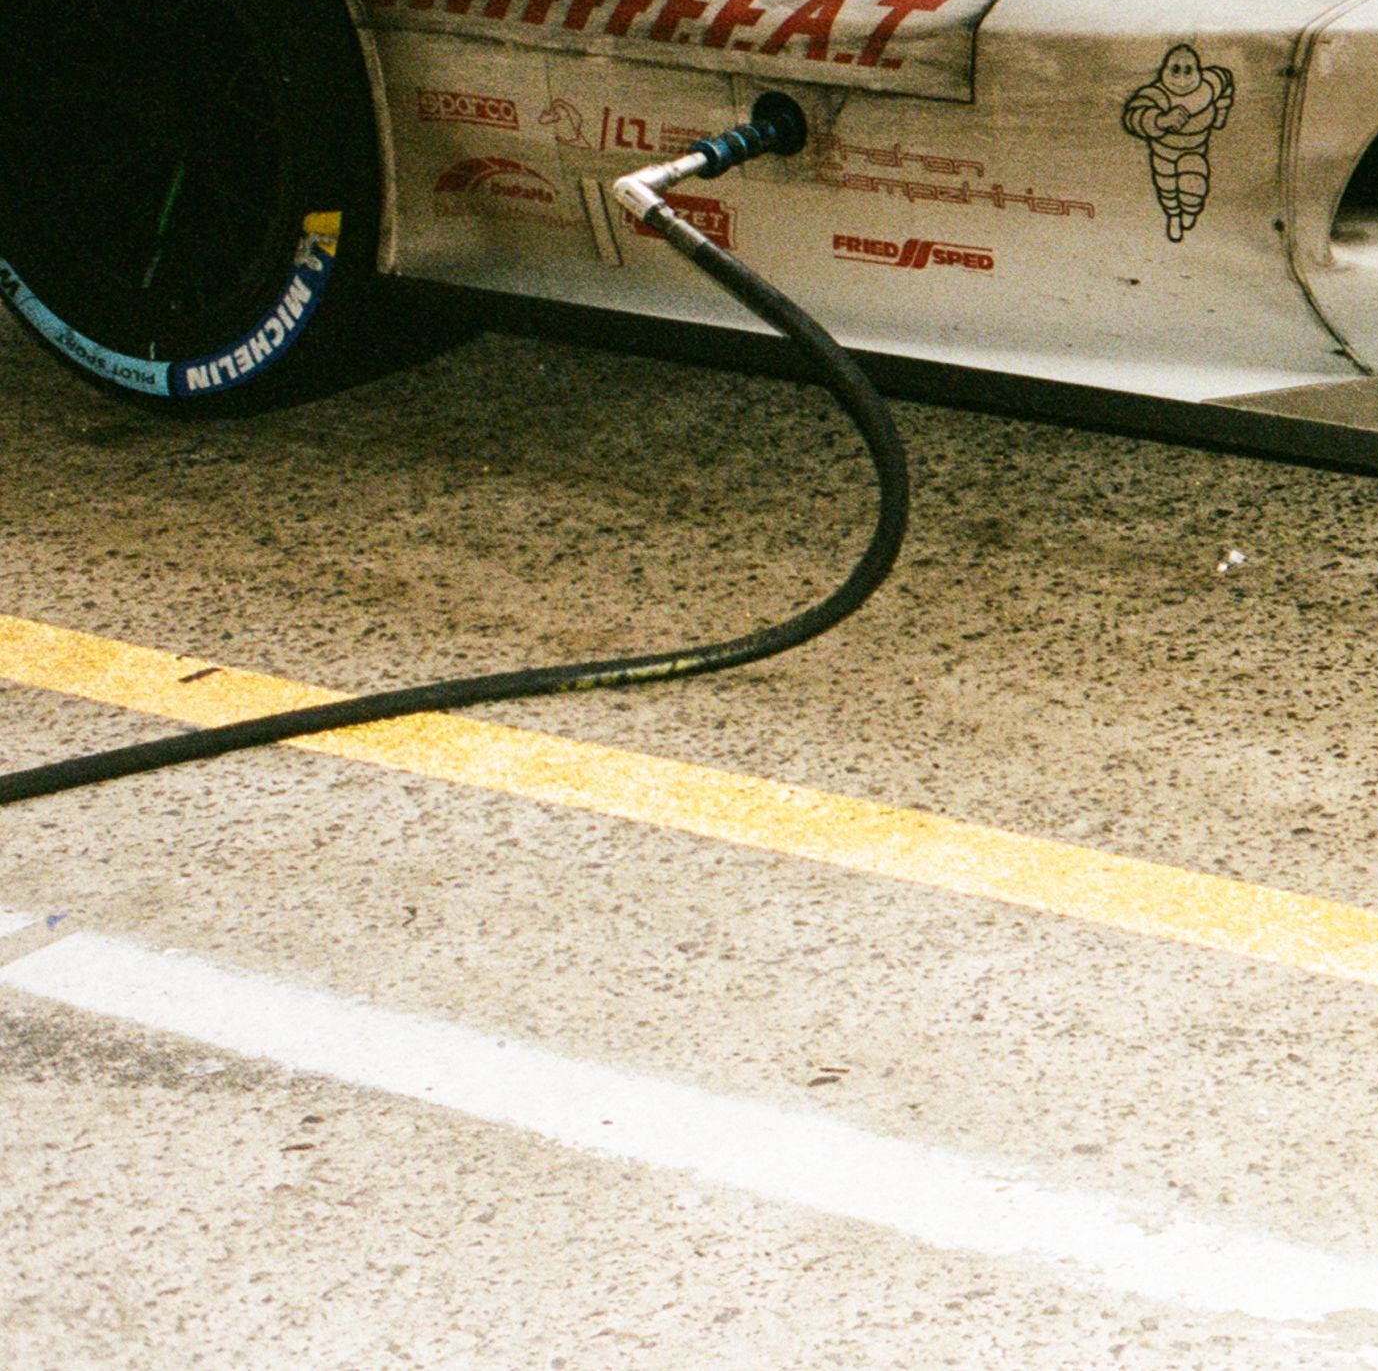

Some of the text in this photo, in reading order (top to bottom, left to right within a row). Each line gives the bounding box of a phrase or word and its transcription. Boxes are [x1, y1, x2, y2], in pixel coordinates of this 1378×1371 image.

[832, 233, 995, 271] FRIED SPED
[185, 275, 312, 392] MICHELIN
